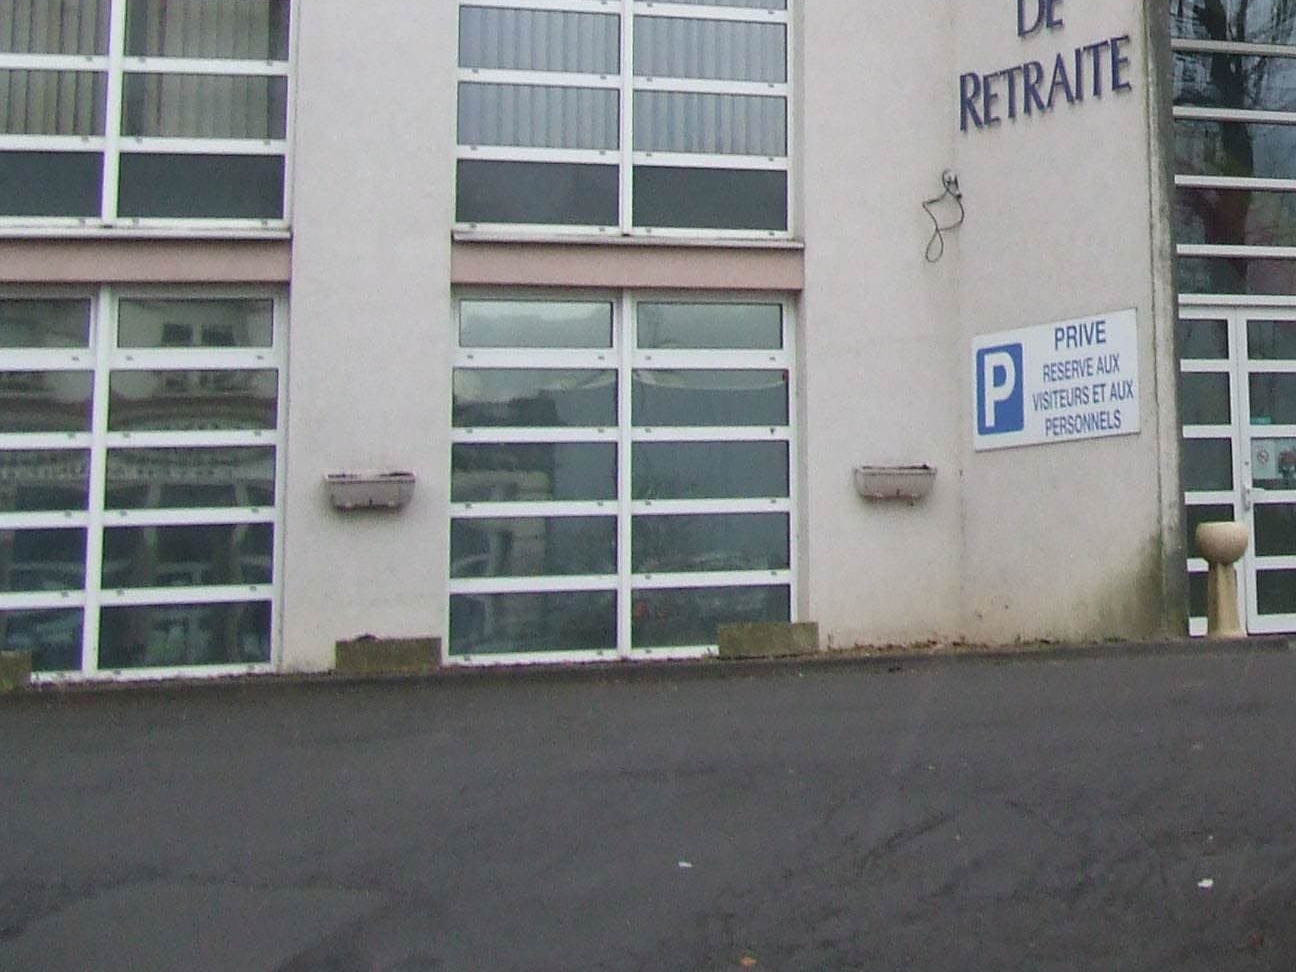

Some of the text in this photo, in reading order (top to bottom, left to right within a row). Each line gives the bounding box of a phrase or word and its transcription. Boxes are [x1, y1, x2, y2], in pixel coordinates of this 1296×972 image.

[959, 34, 1133, 133] RETRAITE
[1054, 320, 1107, 351] PRIVE
[1042, 353, 1120, 384] RESERVE AUX
[984, 351, 1016, 428] P
[1032, 380, 1134, 411] VISITEURS ET AUX
[1045, 409, 1122, 436] PERSONNELS
